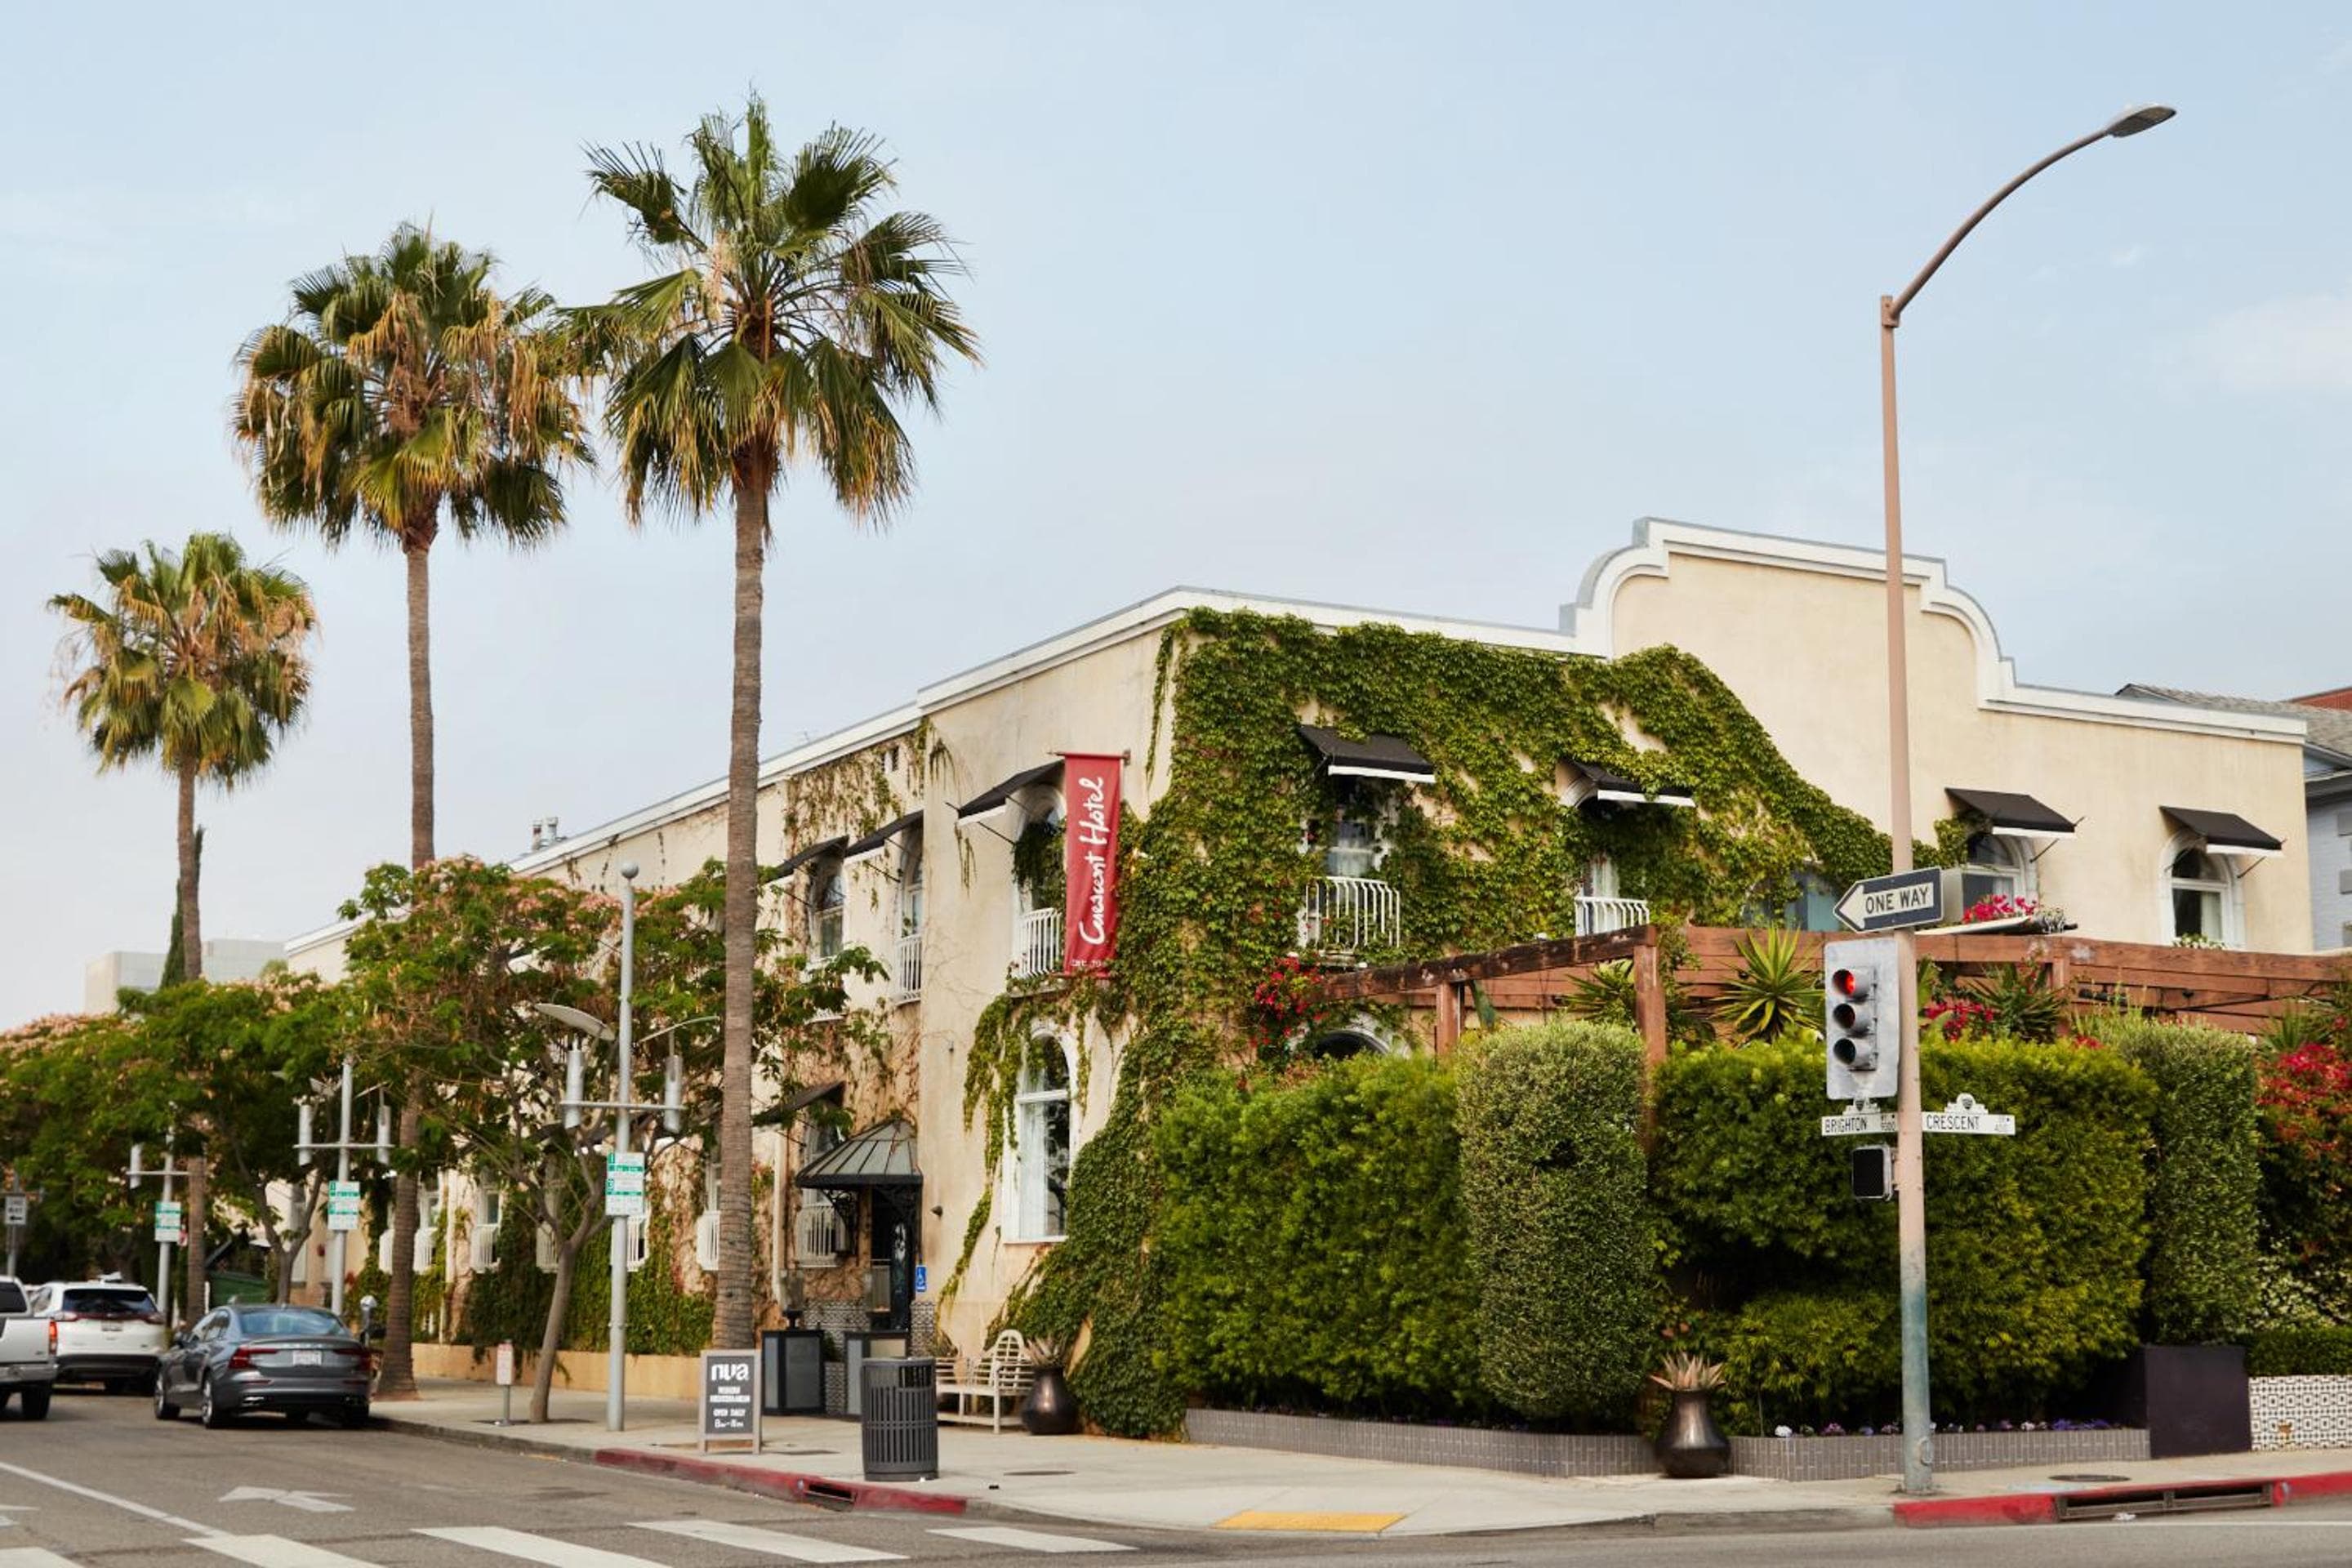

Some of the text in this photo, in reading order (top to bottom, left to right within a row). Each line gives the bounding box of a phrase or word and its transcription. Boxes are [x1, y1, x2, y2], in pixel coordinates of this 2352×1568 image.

[1078, 777, 1110, 945] Crescent Hotel
[1865, 886, 1928, 914] ONE WAY
[1824, 1116, 1868, 1133] BRIGHTON
[1926, 1114, 1980, 1130] CRESCENT
[710, 1363, 751, 1381] nua
